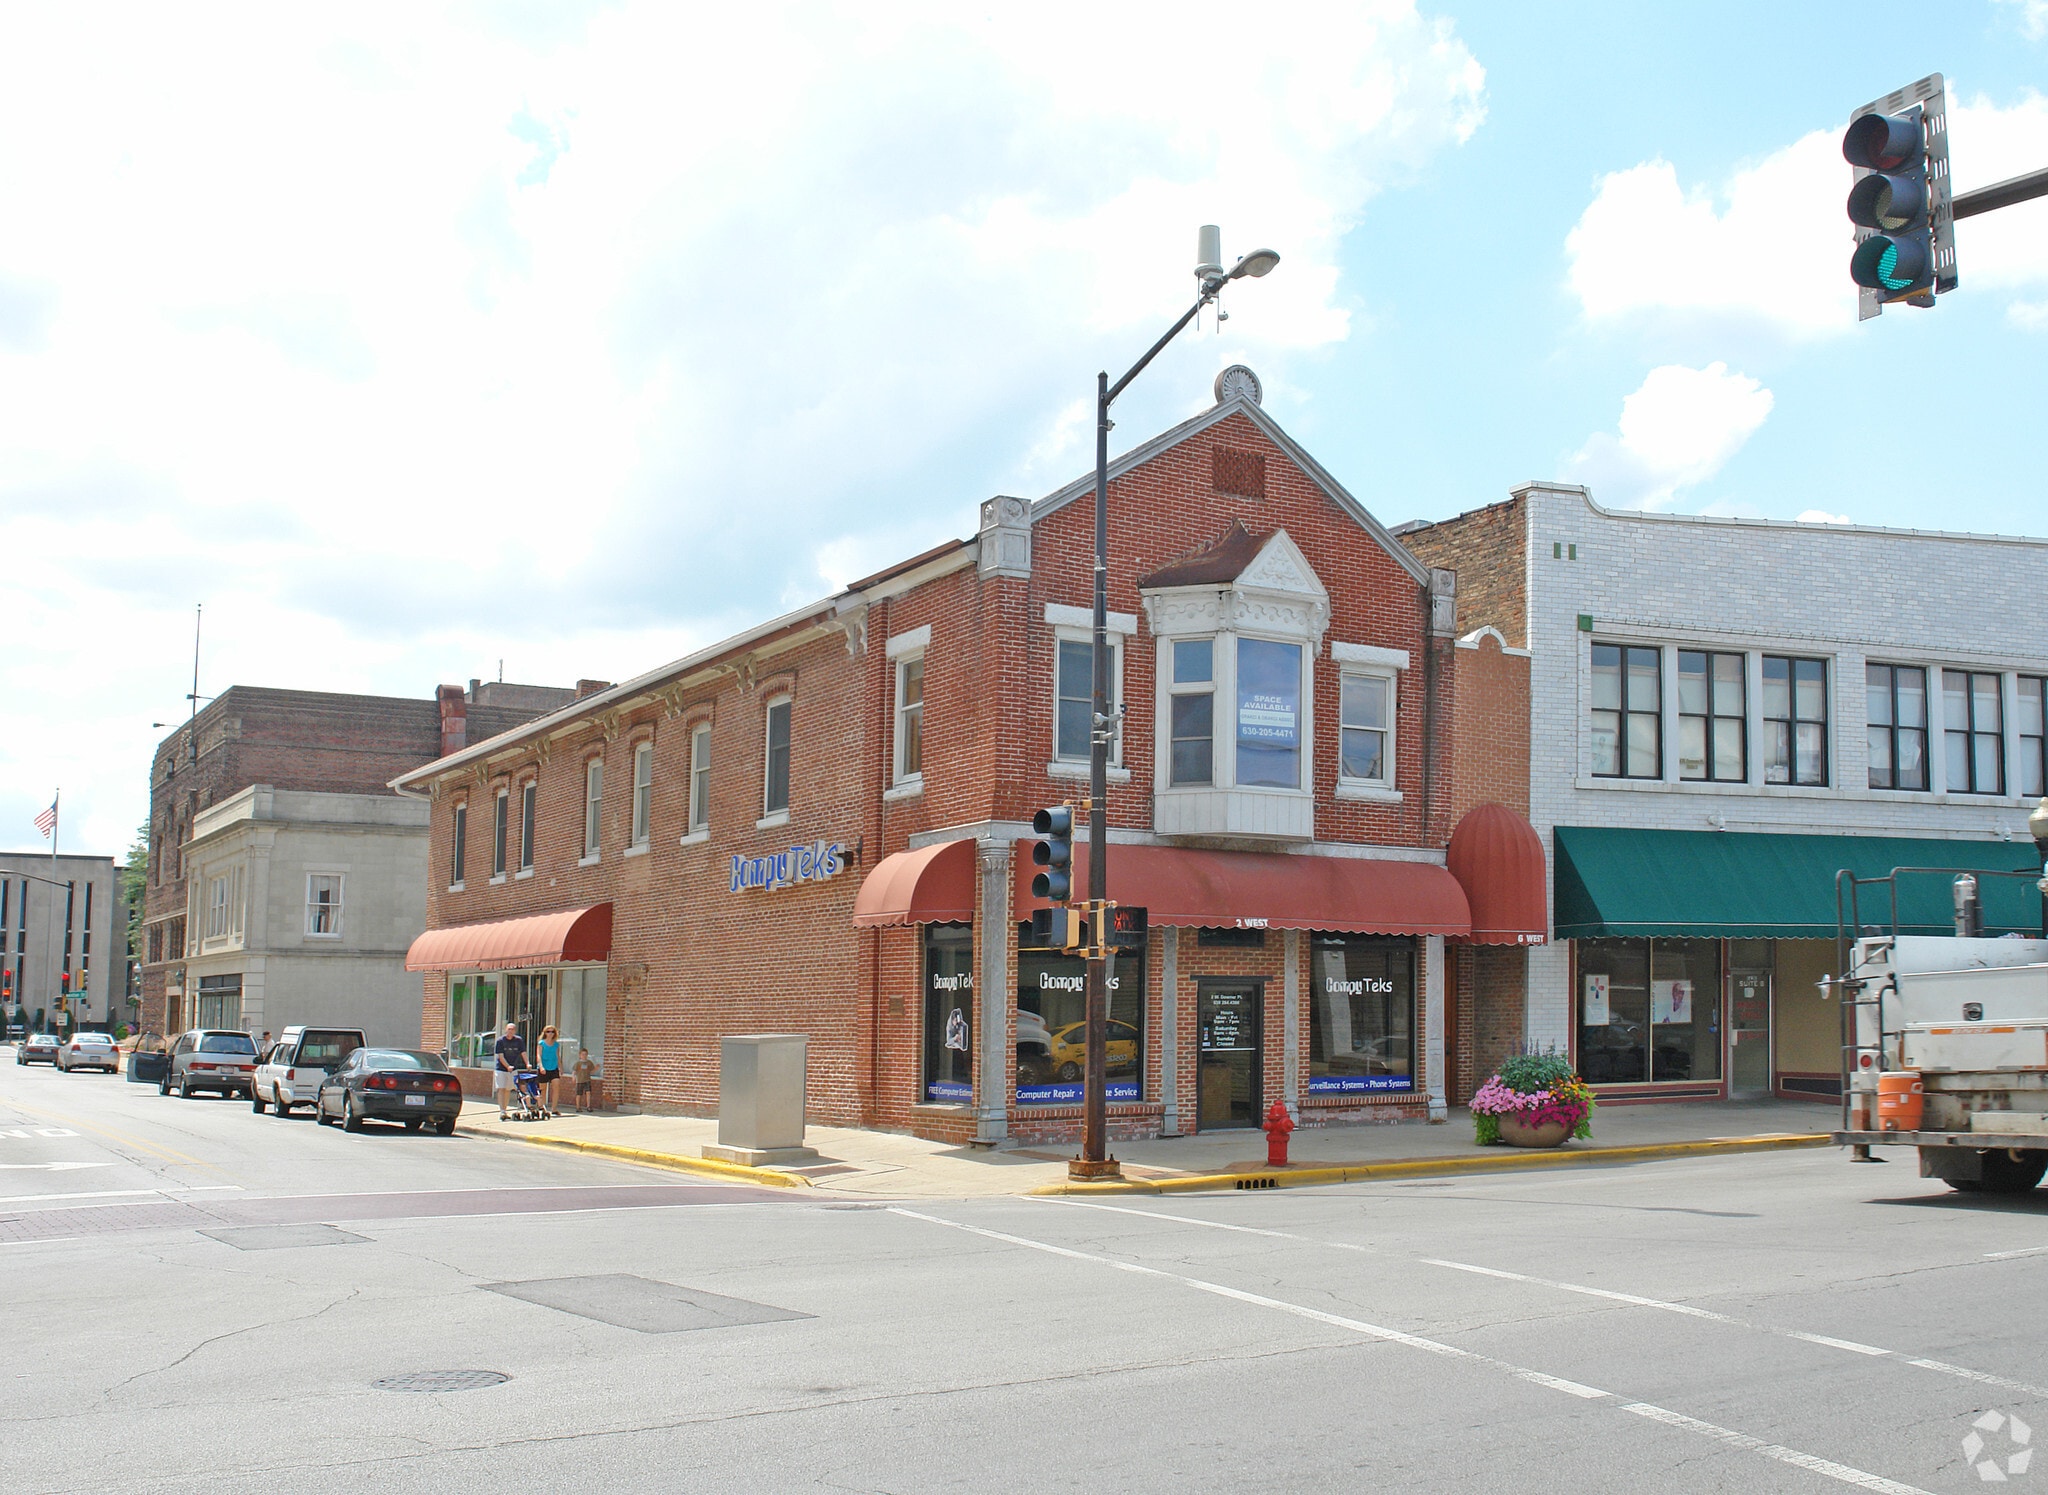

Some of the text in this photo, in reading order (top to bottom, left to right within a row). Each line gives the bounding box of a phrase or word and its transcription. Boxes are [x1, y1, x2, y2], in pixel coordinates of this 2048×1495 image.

[1254, 695, 1282, 703] SPACE
[1244, 702, 1291, 711] AVAILABLE
[1236, 918, 1268, 927] 2 WEST
[1526, 934, 1544, 942] WEST
[1341, 1080, 1365, 1091] Systems
[1369, 1079, 1388, 1088] Phone
[1388, 1079, 1411, 1089] Systems
[939, 1086, 959, 1097] Computer
[1015, 1090, 1051, 1100] Computer
[1053, 1089, 1076, 1099] Repair
[1113, 1087, 1137, 1097] Service
